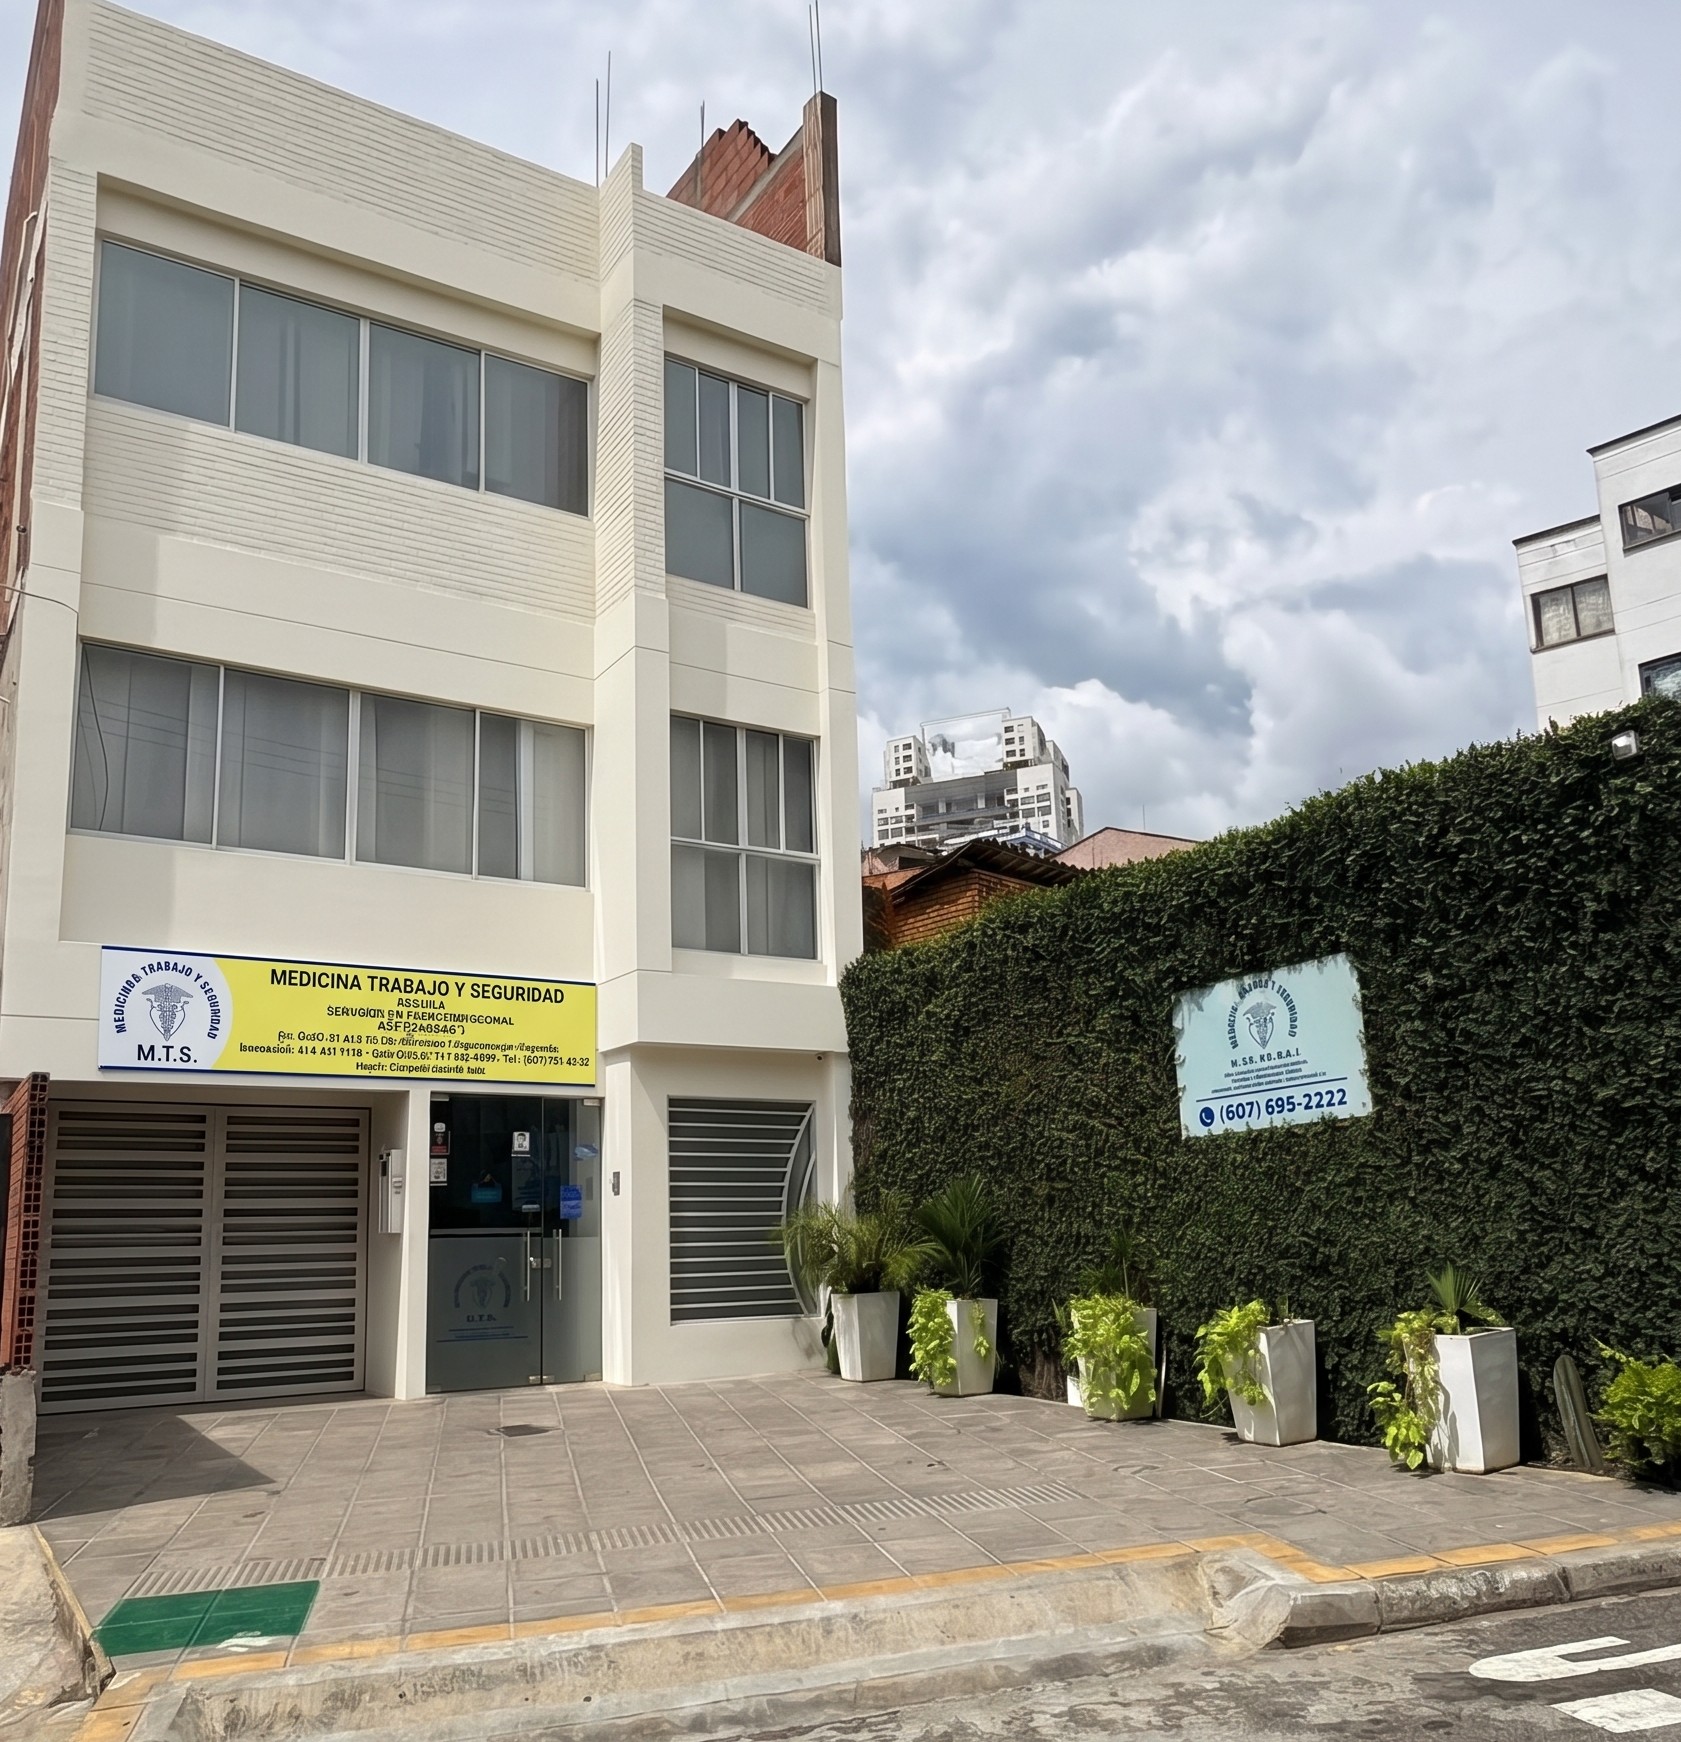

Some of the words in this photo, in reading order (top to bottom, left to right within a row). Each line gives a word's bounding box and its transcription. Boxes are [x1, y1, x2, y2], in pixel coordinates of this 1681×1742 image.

[140, 961, 193, 977] TRABAJO
[194, 973, 203, 983] Y
[270, 969, 362, 991] MEDICINA
[367, 975, 450, 998] TRABAJO
[454, 981, 466, 998] Y
[470, 982, 565, 1004] SEGURIDAD
[137, 1043, 198, 1064] M.T.S.
[1219, 1100, 1262, 1125] (607)
[1264, 1088, 1348, 1117] 695-2222
